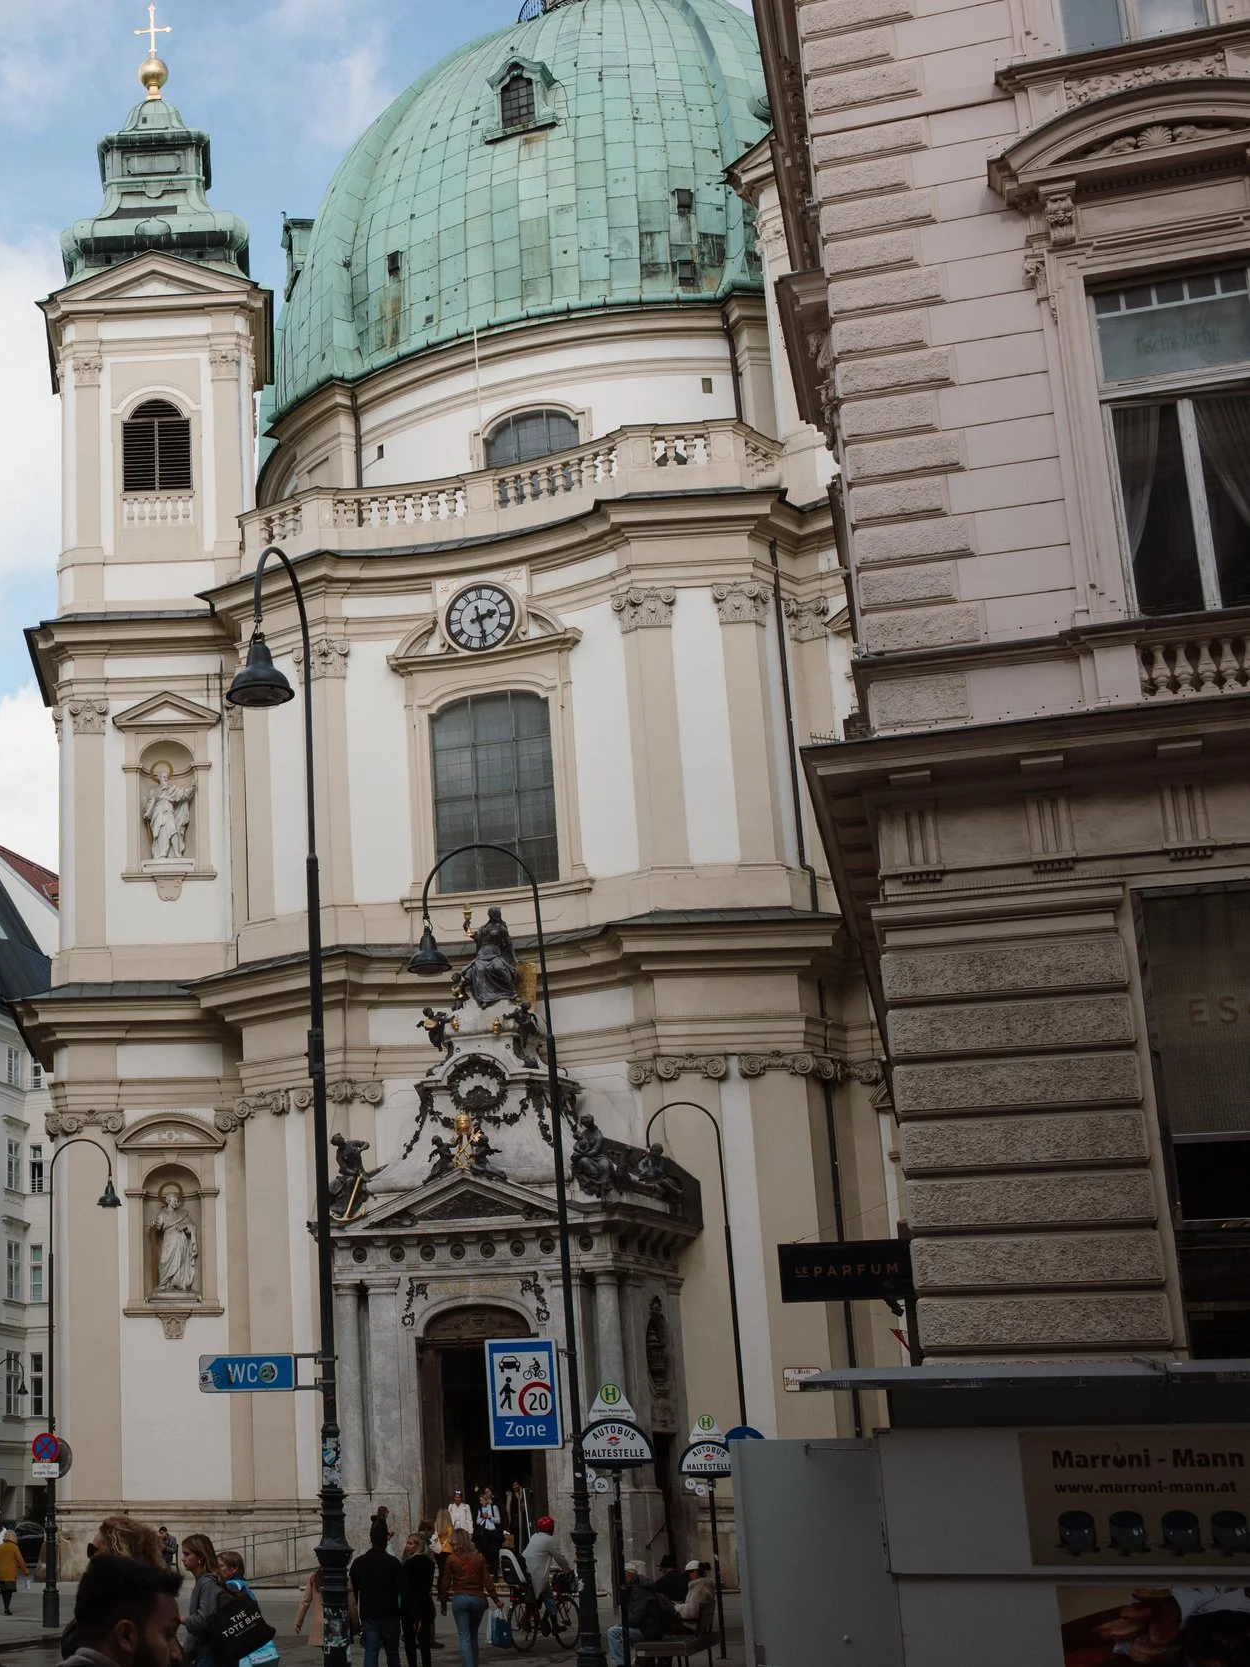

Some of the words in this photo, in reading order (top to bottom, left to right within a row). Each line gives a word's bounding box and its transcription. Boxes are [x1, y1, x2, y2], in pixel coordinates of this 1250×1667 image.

[1188, 995, 1250, 1027] ES
[813, 1263, 899, 1277] PARFUM
[228, 1363, 258, 1383] WC
[528, 1392, 548, 1411] 20
[605, 1387, 617, 1401] H
[505, 1421, 547, 1437] Zone
[701, 1417, 711, 1428] H
[592, 1425, 637, 1441] AUTOBUS
[585, 1449, 645, 1458] HALTESTELLE
[692, 1446, 726, 1458] AUTOBUS
[1052, 1448, 1152, 1469] Marroni
[1172, 1449, 1245, 1468] Mann
[1054, 1481, 1238, 1494] www.marroni-mann.at
[230, 1610, 247, 1623] THE
[222, 1621, 245, 1638] TOTE
